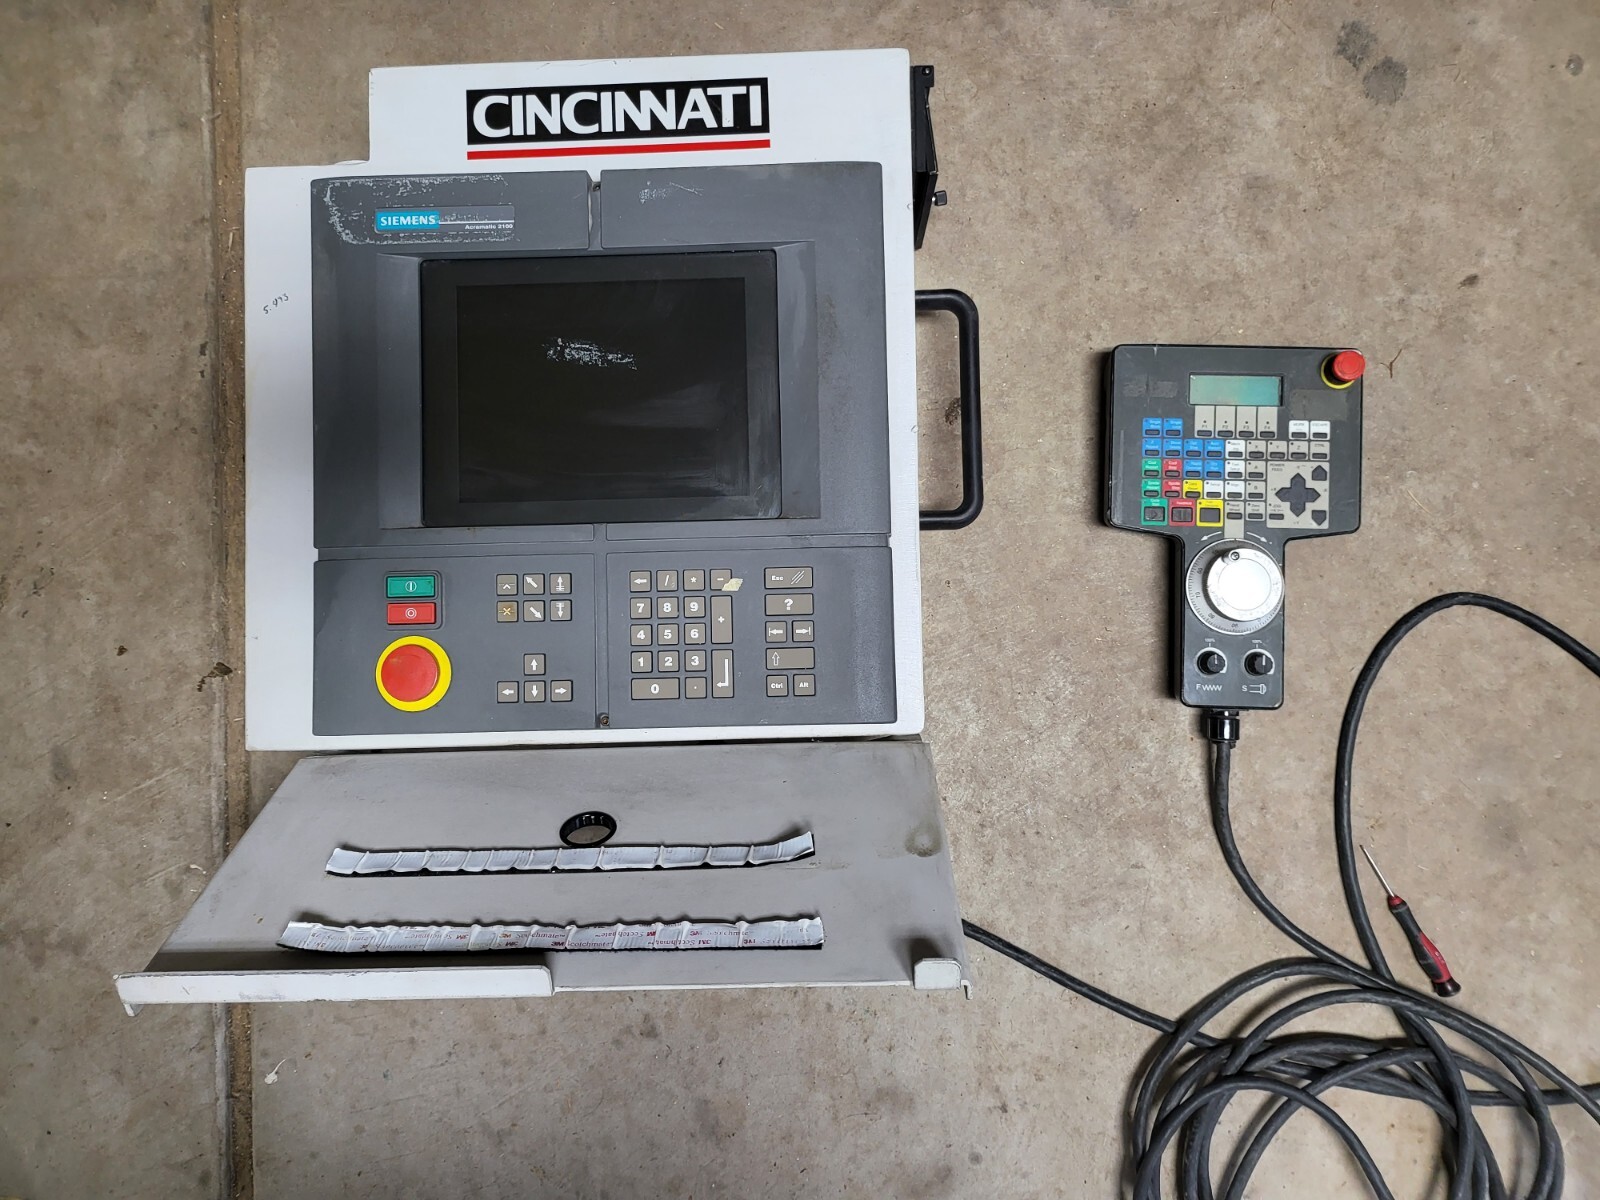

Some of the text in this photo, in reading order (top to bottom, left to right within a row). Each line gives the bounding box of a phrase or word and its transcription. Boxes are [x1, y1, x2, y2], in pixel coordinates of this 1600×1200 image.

[472, 84, 763, 139] CINCINNATI
[380, 215, 436, 226] SIEMENS
[636, 603, 645, 613] 7
[663, 602, 672, 612] 8
[689, 601, 699, 612] 9
[783, 598, 794, 611] ?
[636, 629, 646, 640] 4
[663, 629, 672, 639] 5
[690, 629, 699, 639] 6
[637, 656, 644, 667] 1
[664, 656, 673, 667] 2
[690, 655, 699, 666] 3
[650, 683, 660, 694] 0
